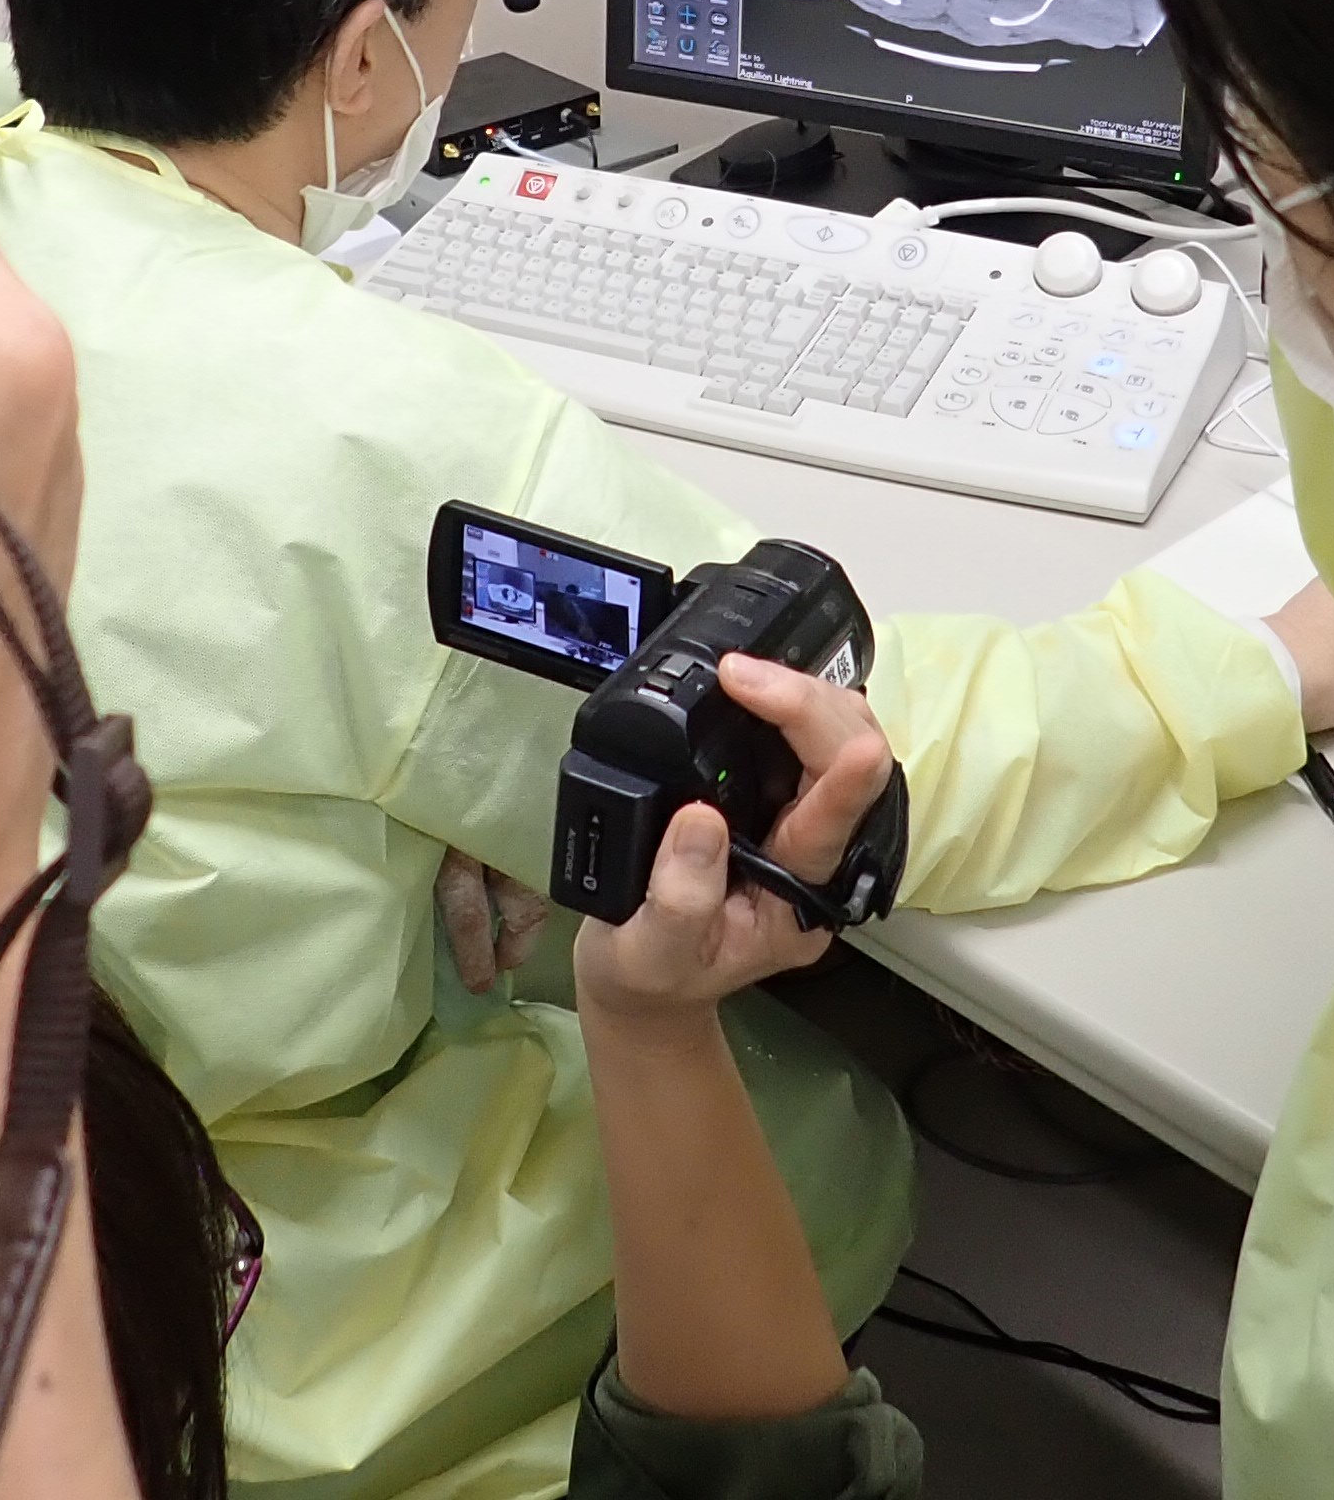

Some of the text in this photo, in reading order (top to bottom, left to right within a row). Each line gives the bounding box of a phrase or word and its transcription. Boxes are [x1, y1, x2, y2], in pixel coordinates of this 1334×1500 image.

[740, 69, 813, 89] Aquilion Lightning
[905, 94, 914, 104] P
